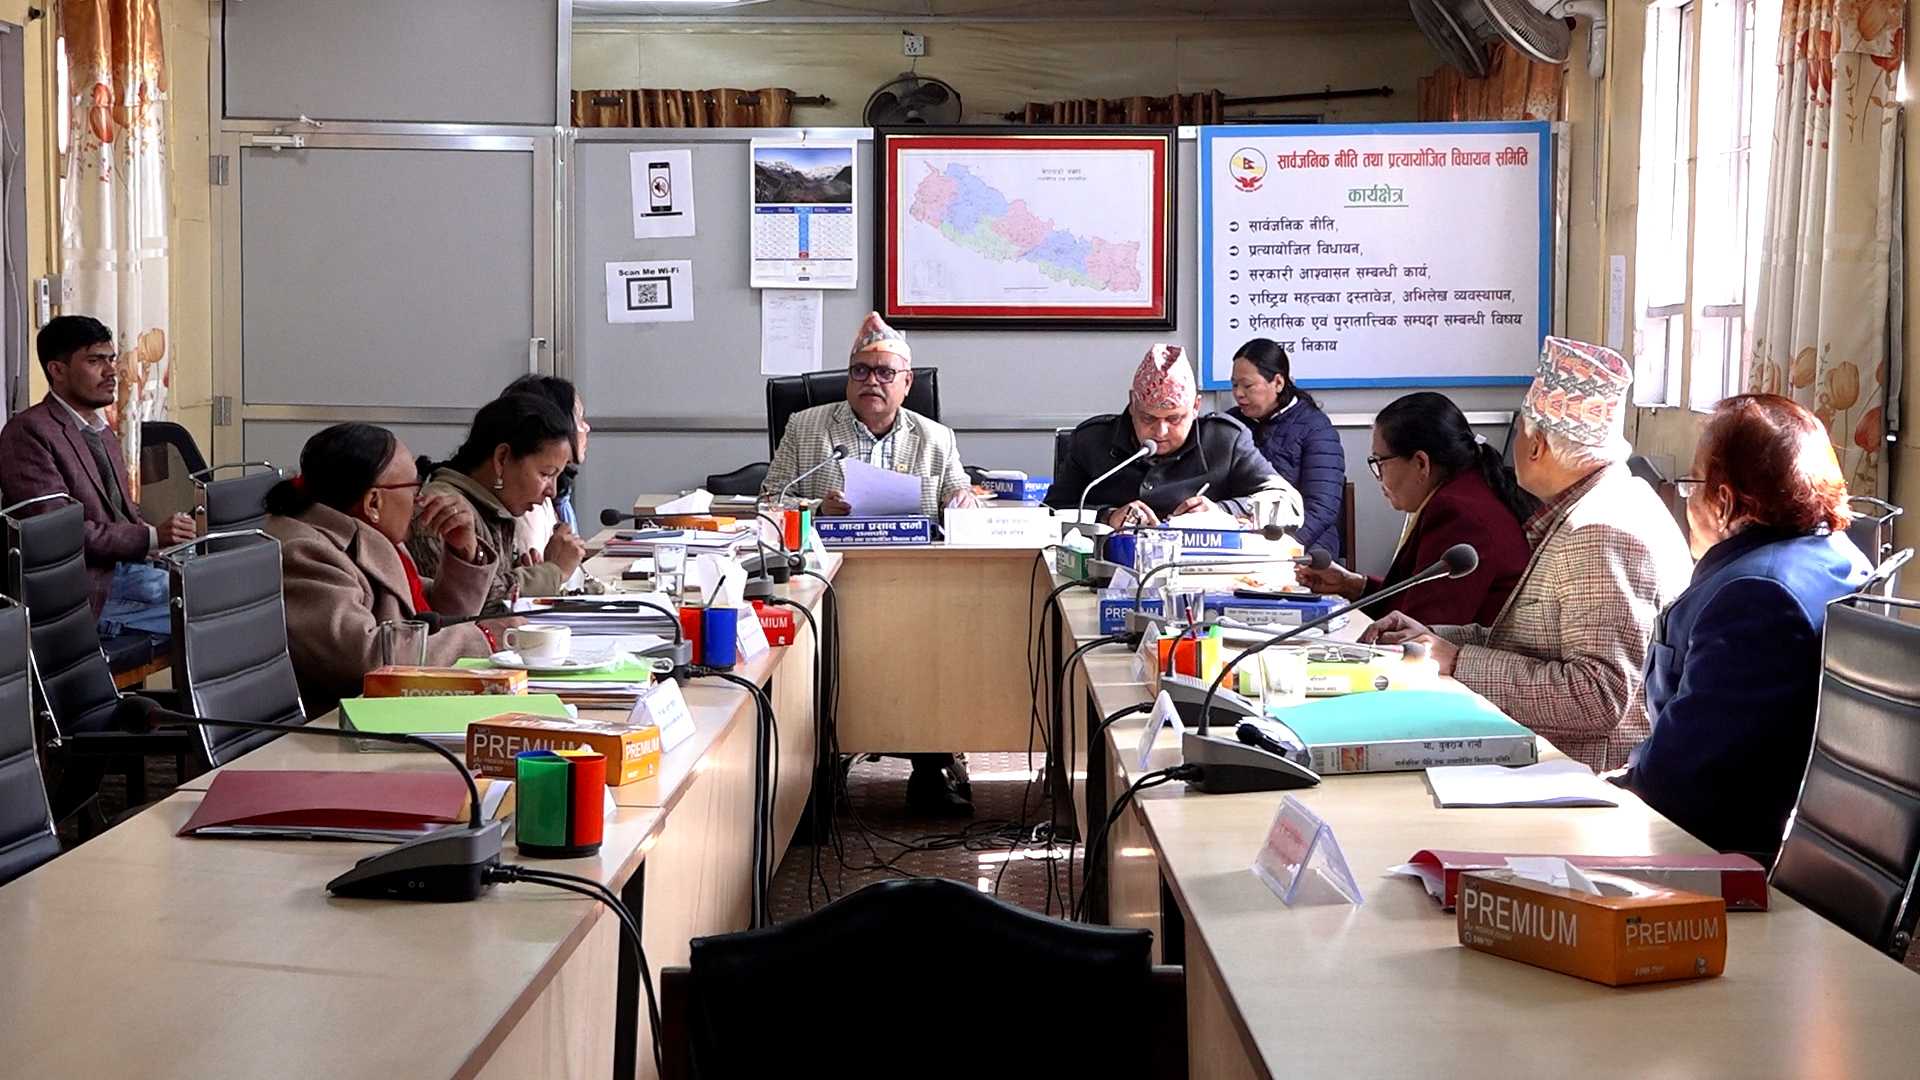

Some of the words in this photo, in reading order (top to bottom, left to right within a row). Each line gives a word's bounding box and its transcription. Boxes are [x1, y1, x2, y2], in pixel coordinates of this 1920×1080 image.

[1278, 150, 1330, 170] सार्वजनिक
[1334, 149, 1358, 168] नीति
[1363, 152, 1383, 168] तथा
[1388, 148, 1447, 169] प्रत्यायोजित
[1452, 148, 1490, 167] विधायन
[1496, 146, 1528, 167] समिति
[1348, 184, 1404, 203] कार्यक्षेत्र
[1249, 216, 1304, 233] सार्वजनिक
[1309, 216, 1339, 232] नीति,
[1249, 240, 1311, 257] प्रत्यायोजित
[1317, 240, 1363, 256] विधायन,
[1249, 265, 1293, 281] सरकारी
[1300, 268, 1350, 280] आश्वासन
[1356, 264, 1398, 280] सम्बन्धी
[1404, 263, 1431, 279] कार्य,
[1249, 290, 1288, 308] राष्ट्रिय
[1347, 289, 1395, 304] दस्तावेज,
[1403, 287, 1448, 302] अभिलेख
[1454, 290, 1515, 303] व्यवस्थापन,
[1249, 313, 1305, 331] ऐतिहासिक
[1312, 314, 1328, 330] एवं
[1404, 314, 1438, 328] सम्पदा
[1444, 310, 1485, 326] सम्बन्धी
[1491, 310, 1523, 325] विषय
[1301, 337, 1338, 351] निकाय
[981, 481, 1014, 492] PREMIUM
[900, 521, 922, 530] शर्मा
[1182, 533, 1222, 547] MIUM
[760, 617, 787, 628] MIUM
[626, 737, 659, 760] PREMIUM
[1464, 889, 1577, 947] PREMIUM
[1626, 917, 1718, 946] PREMIUM
